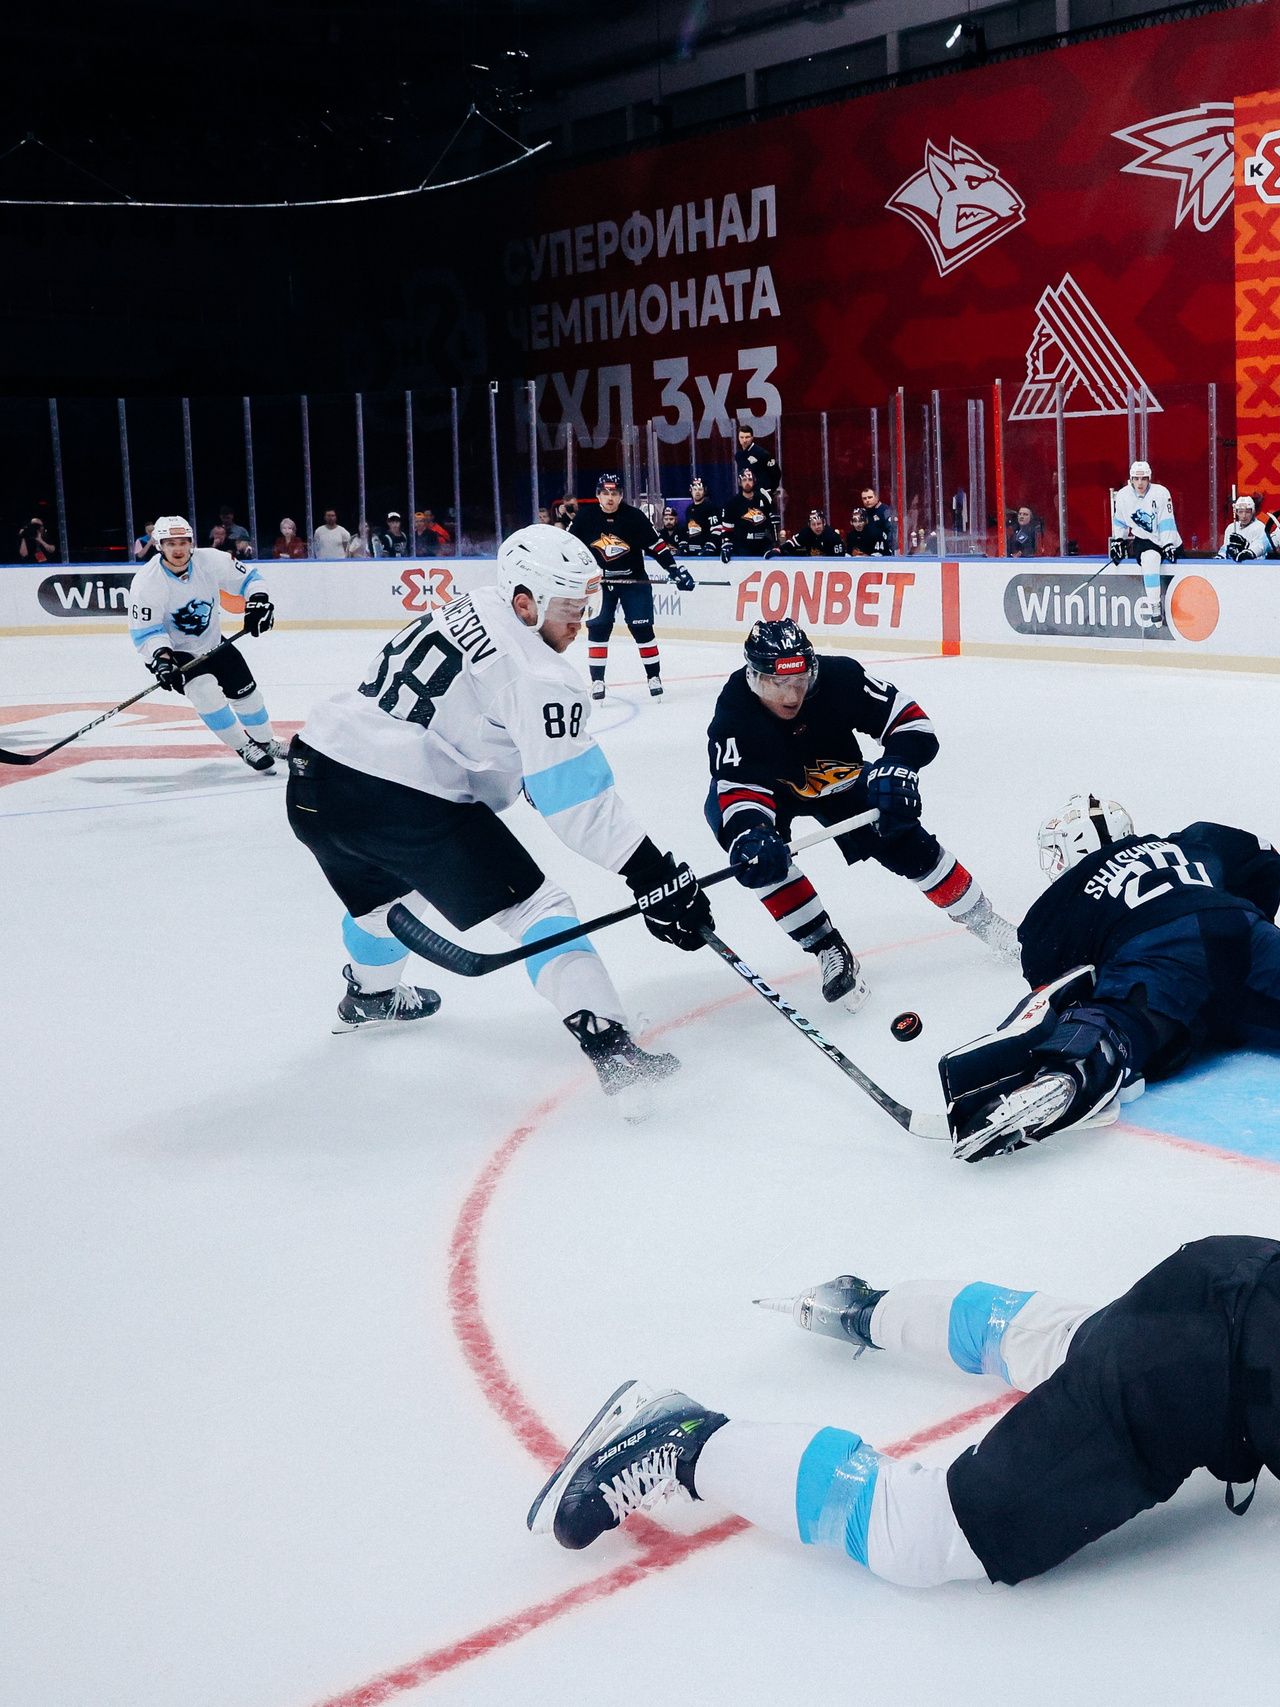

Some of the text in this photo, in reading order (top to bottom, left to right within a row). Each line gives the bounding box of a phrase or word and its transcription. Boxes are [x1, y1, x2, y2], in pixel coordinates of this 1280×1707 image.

[504, 184, 777, 285] СУПЕРФИНАЛ
[507, 265, 781, 351] ЧЕМПИОНАТА
[513, 363, 635, 452] КХЛ
[132, 604, 151, 621] 69
[736, 570, 916, 628] FONBET
[1016, 584, 1162, 629] Winline
[781, 638, 793, 650] 14
[777, 660, 804, 670] FONBET
[864, 670, 893, 703] 14
[542, 702, 583, 738] 88
[715, 737, 742, 770] 14
[867, 766, 918, 788] AUER
